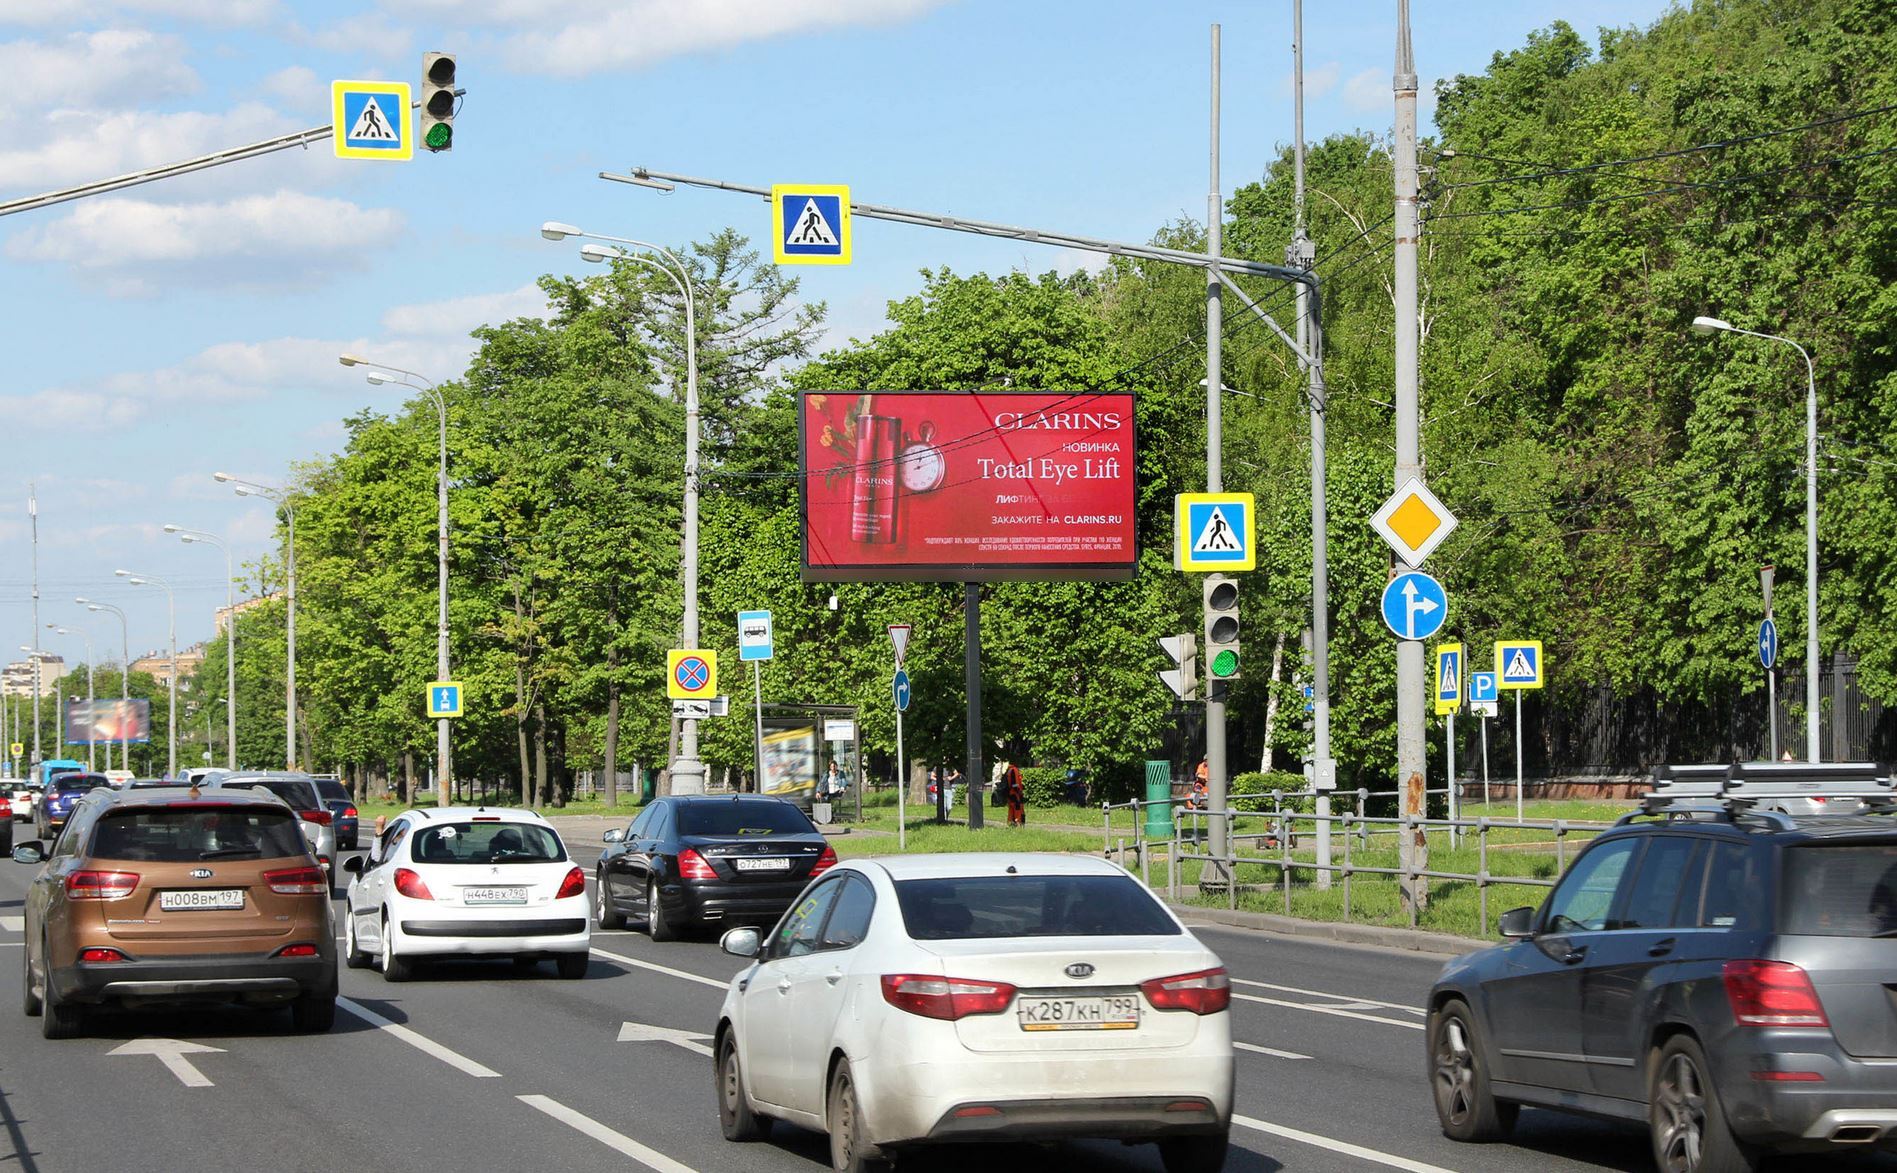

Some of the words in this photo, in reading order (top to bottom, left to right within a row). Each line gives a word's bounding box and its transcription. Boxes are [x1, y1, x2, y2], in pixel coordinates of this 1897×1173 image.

[995, 413, 1120, 429] CLARINS
[1063, 443, 1120, 452] НОВИНКА
[978, 458, 1033, 478] Total
[1040, 458, 1077, 485] Eye
[1084, 457, 1120, 478] Lift
[992, 516, 1042, 524] ЗАКАЖИТЕ
[1046, 516, 1059, 524] НА
[1064, 516, 1122, 524] CLARINS.RU
[1477, 676, 1491, 697] P
[166, 894, 217, 906] Н008ВМ
[220, 892, 238, 901] 197
[1070, 965, 1092, 977] KIA
[1027, 1002, 1100, 1020] К287КН
[1104, 998, 1132, 1014] 799
